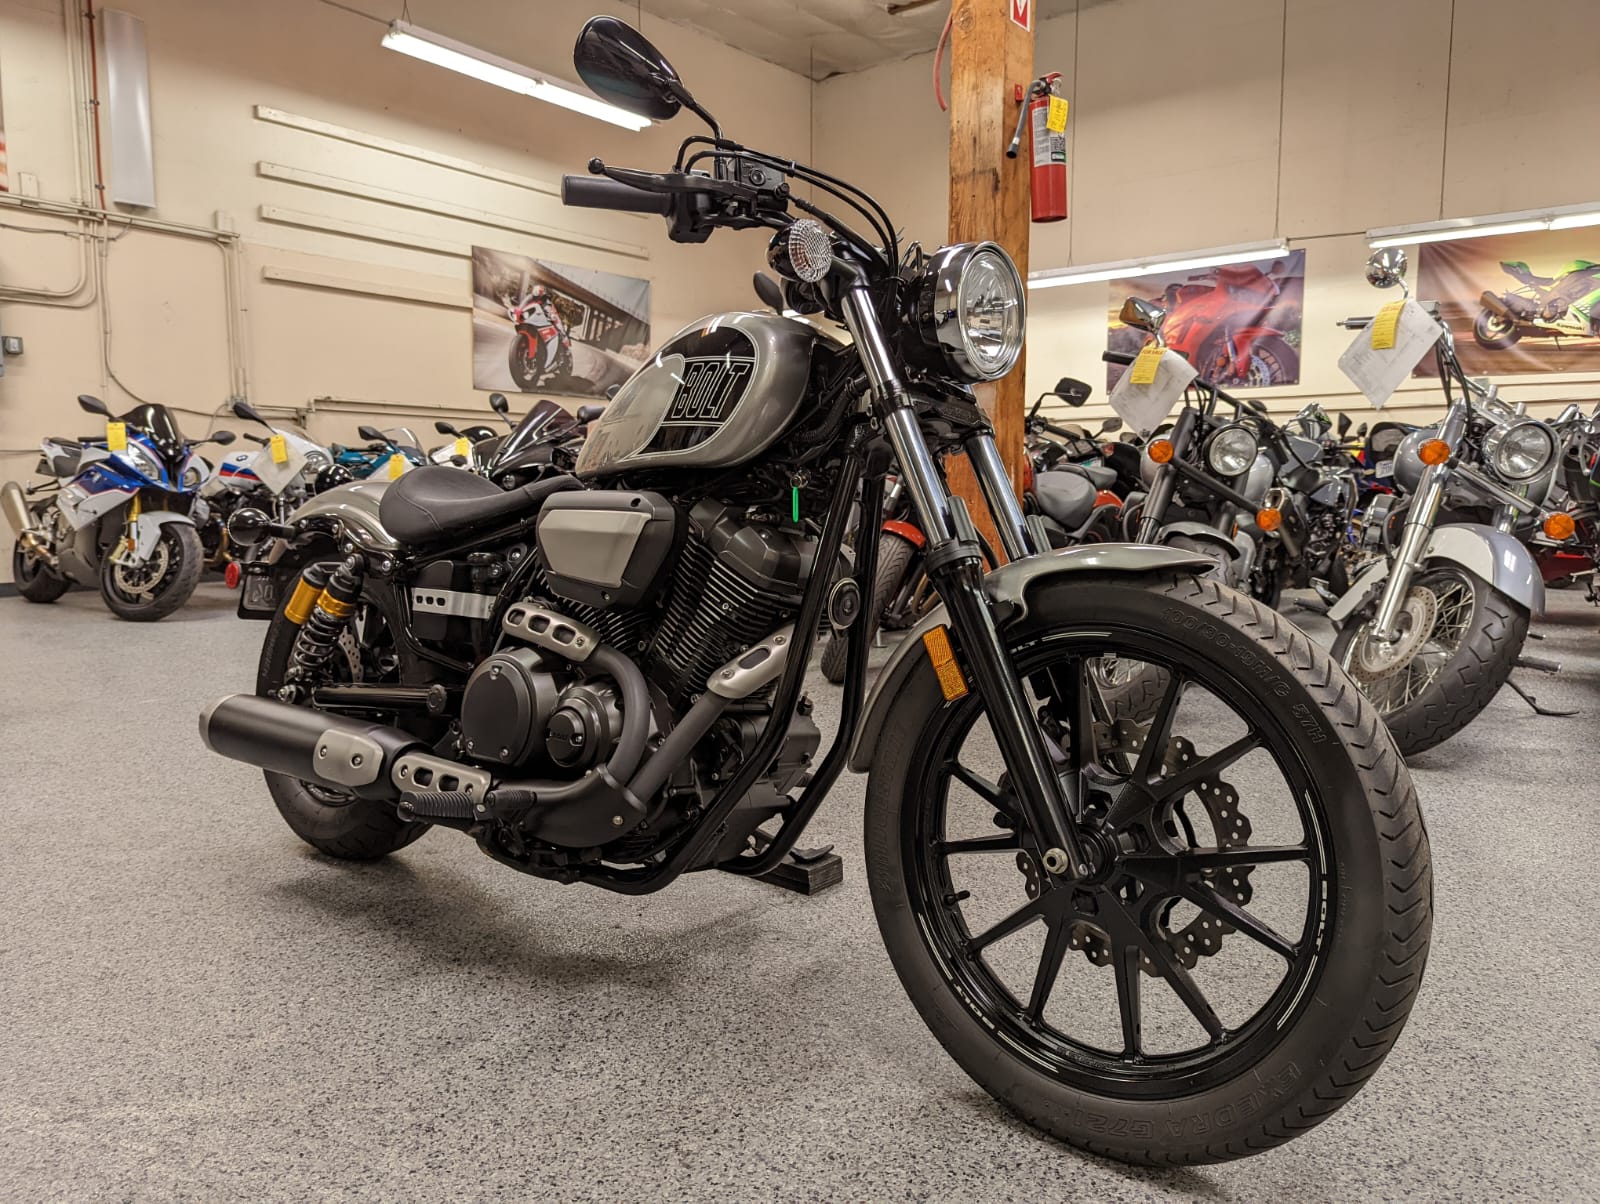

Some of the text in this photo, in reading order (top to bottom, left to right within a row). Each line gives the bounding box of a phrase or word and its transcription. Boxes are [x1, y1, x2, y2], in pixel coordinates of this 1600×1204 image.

[671, 362, 750, 418] BOLT
[1315, 880, 1327, 952] BOLT
[953, 983, 995, 1030] BOLT
